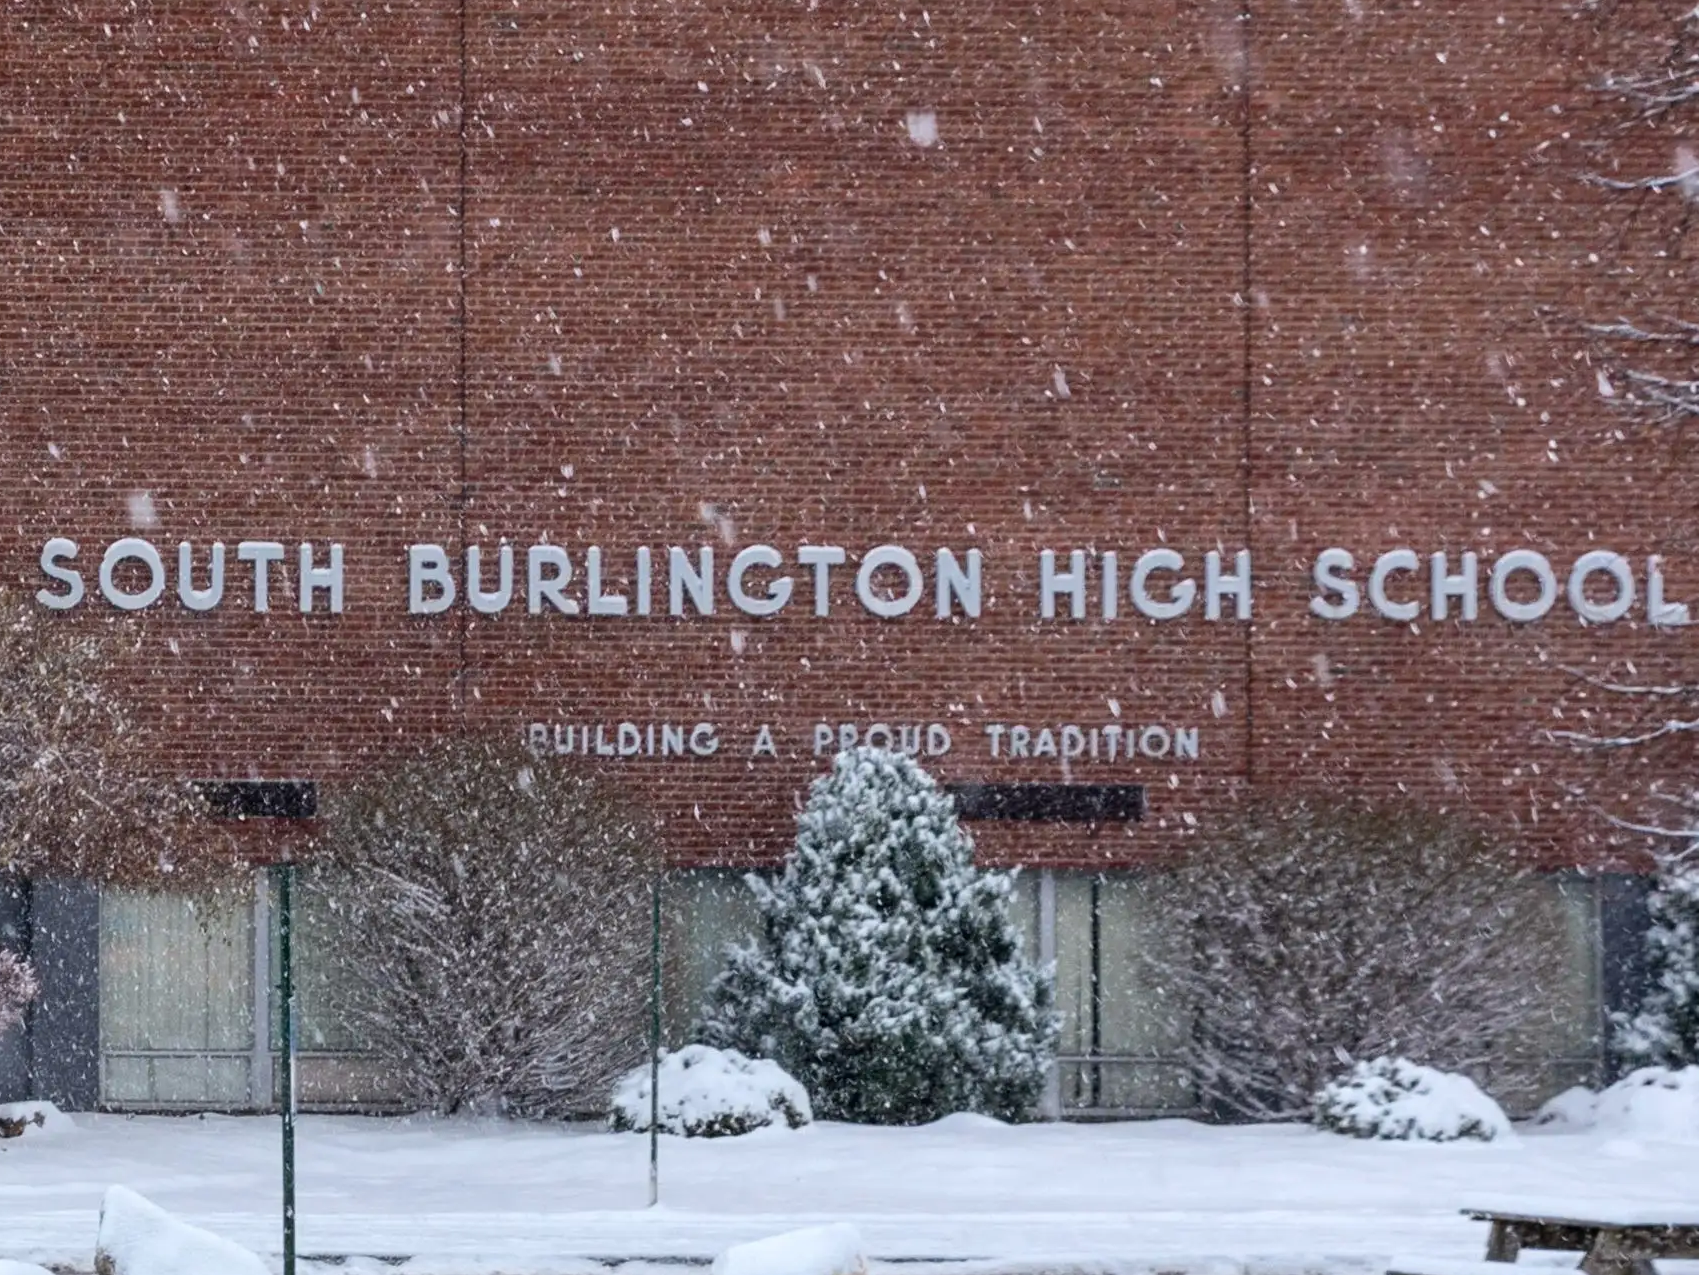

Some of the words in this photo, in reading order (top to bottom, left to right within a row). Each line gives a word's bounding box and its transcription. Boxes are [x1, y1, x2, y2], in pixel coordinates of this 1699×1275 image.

[36, 538, 344, 614] SOUTH
[409, 544, 982, 619] BURLINGTON
[1040, 547, 1252, 621] HIGH
[1310, 548, 1690, 624] SCHOOL
[529, 722, 720, 756] BUILDING
[752, 724, 778, 756] A
[985, 725, 1199, 759] TRADITION
